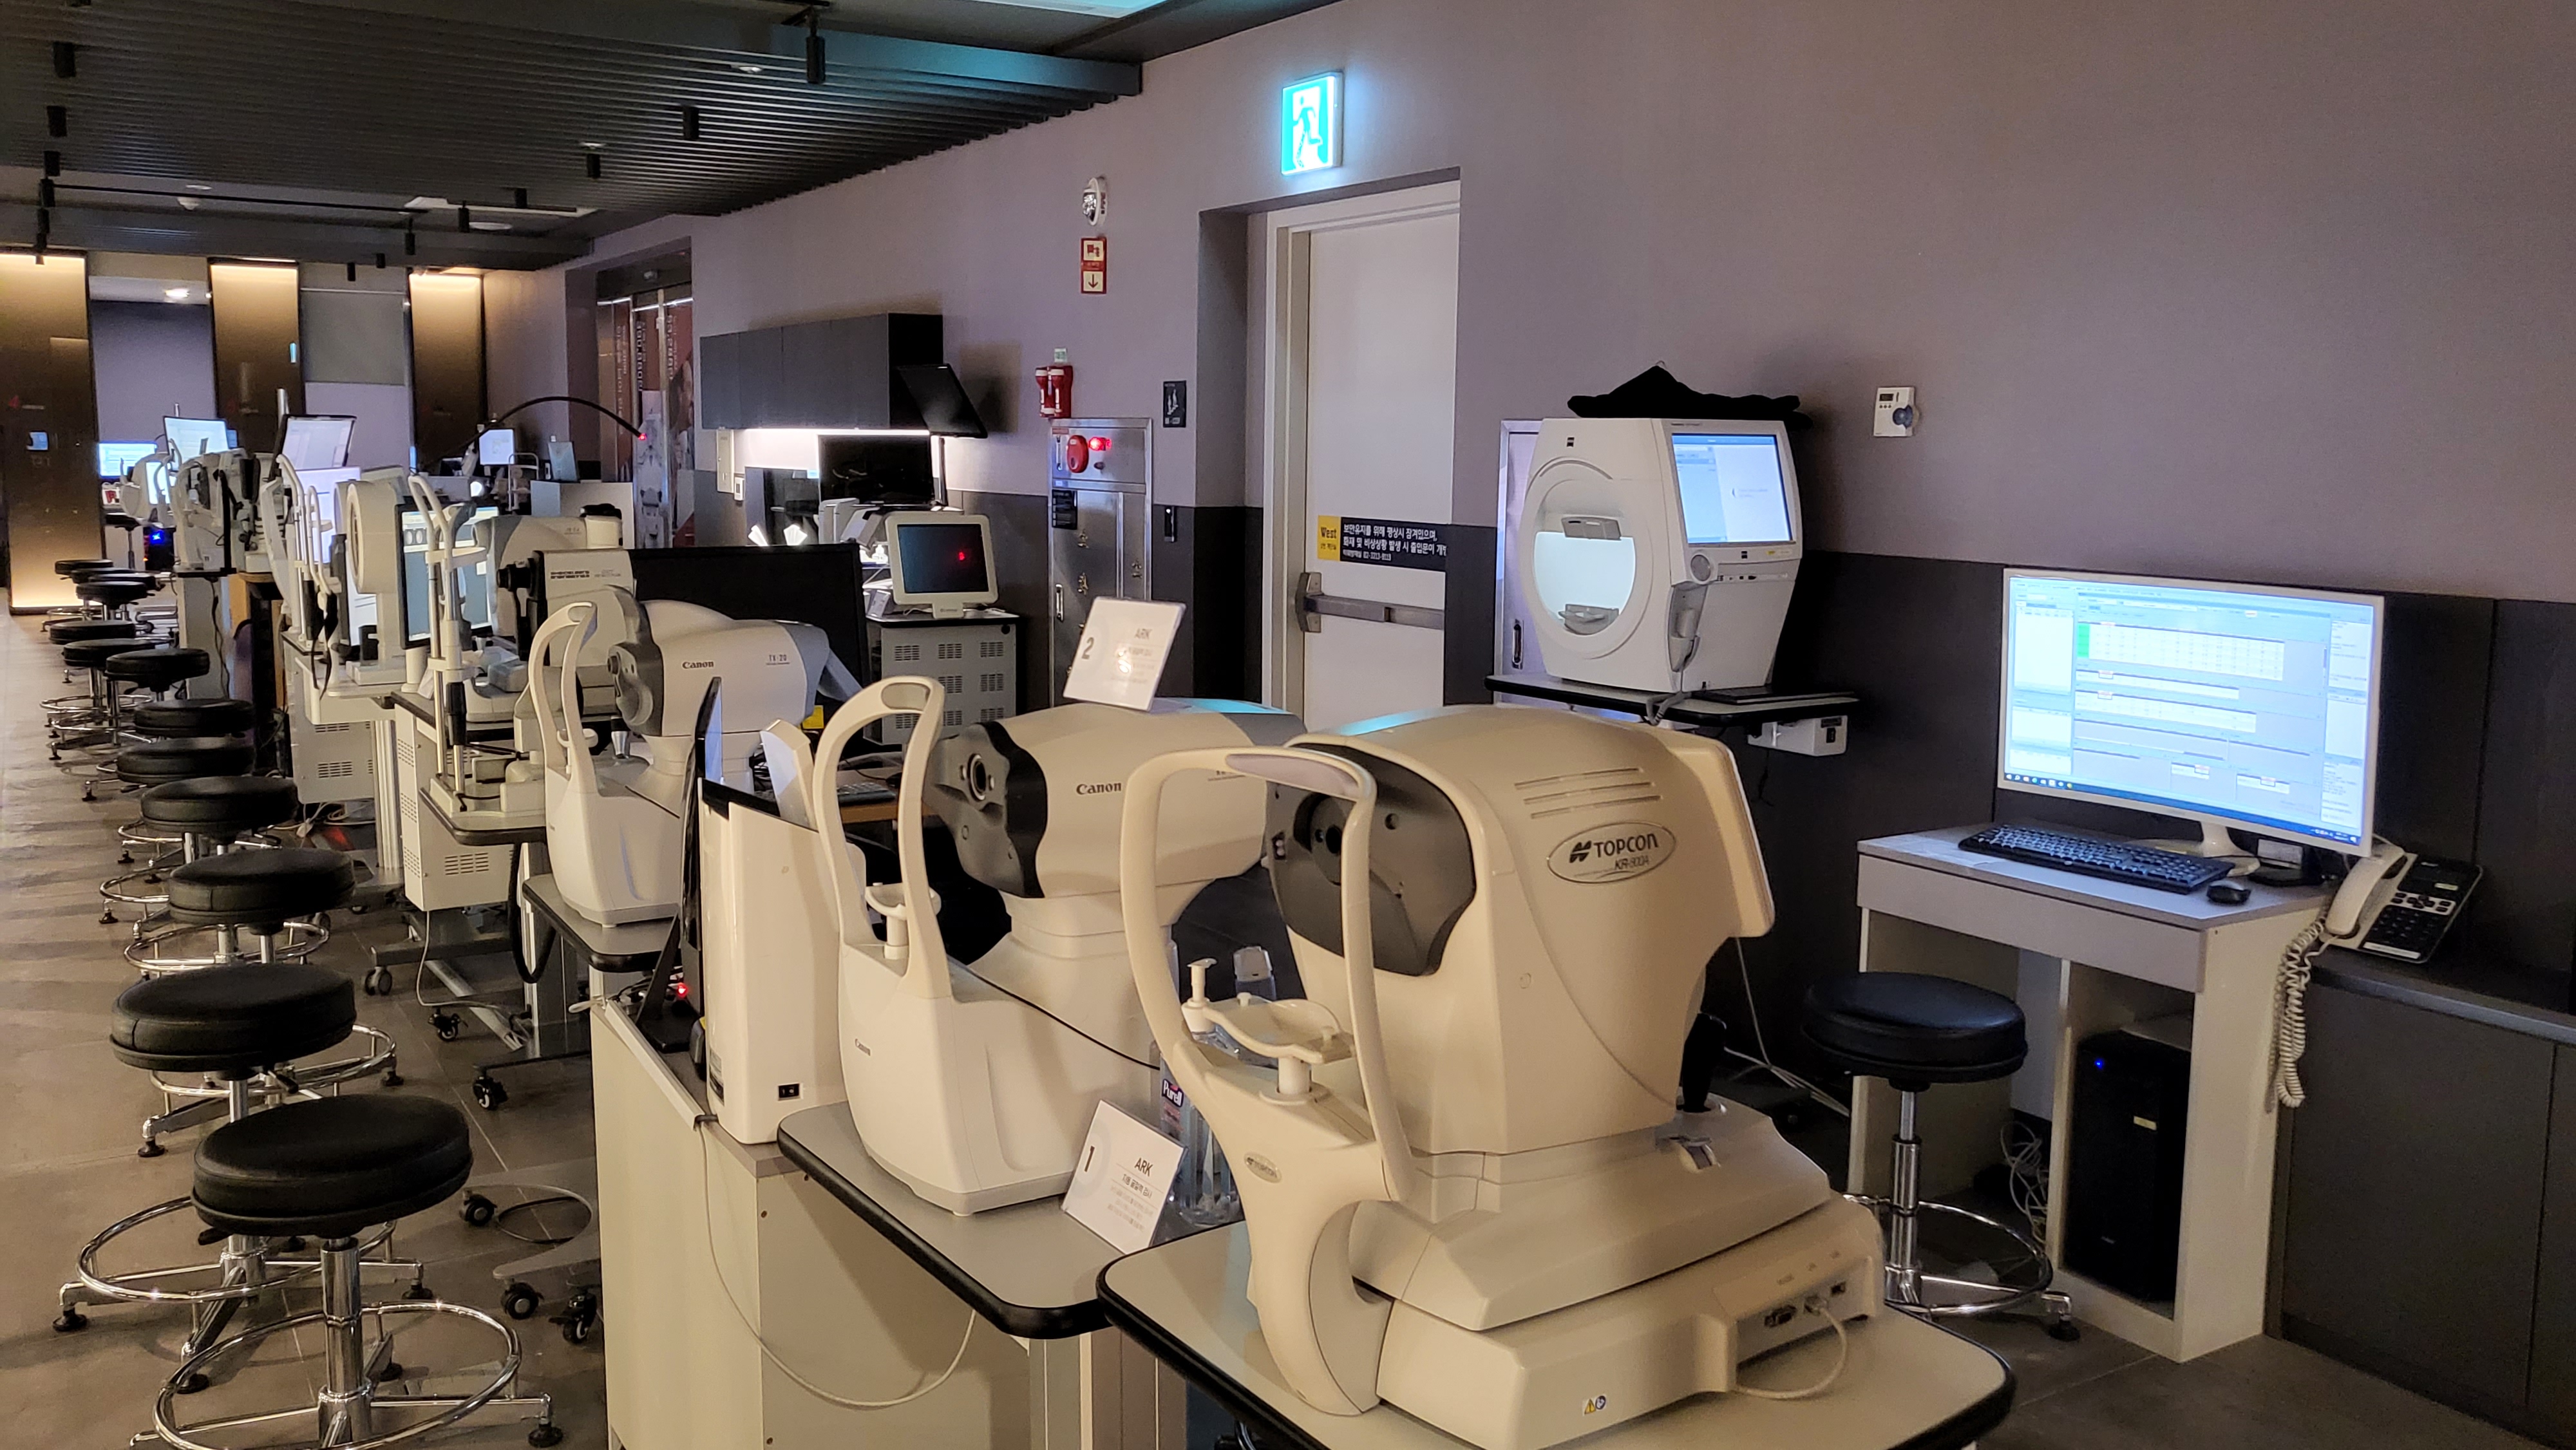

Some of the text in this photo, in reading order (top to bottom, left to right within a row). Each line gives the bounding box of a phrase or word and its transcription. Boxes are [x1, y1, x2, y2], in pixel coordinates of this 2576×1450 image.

[1320, 527, 1337, 539] West
[1343, 524, 1438, 541] 보안유지를 위해 평상시 잠겨있으며,
[1343, 536, 1355, 547] 화재
[1356, 537, 1363, 548] 및
[1364, 538, 1388, 551] 비상상황
[1388, 540, 1401, 552] 발생
[1403, 541, 1409, 552] 시
[1410, 543, 1435, 555] 출입문이
[1081, 637, 1095, 659] 2
[682, 661, 714, 669] Canon
[1076, 782, 1122, 795] Canon
[1594, 833, 1658, 858] TOPCON
[1163, 1080, 1182, 1107] Purell
[1084, 1145, 1095, 1172] 1
[1134, 1157, 1154, 1176] ARK
[1142, 1187, 1153, 1199] 검사
